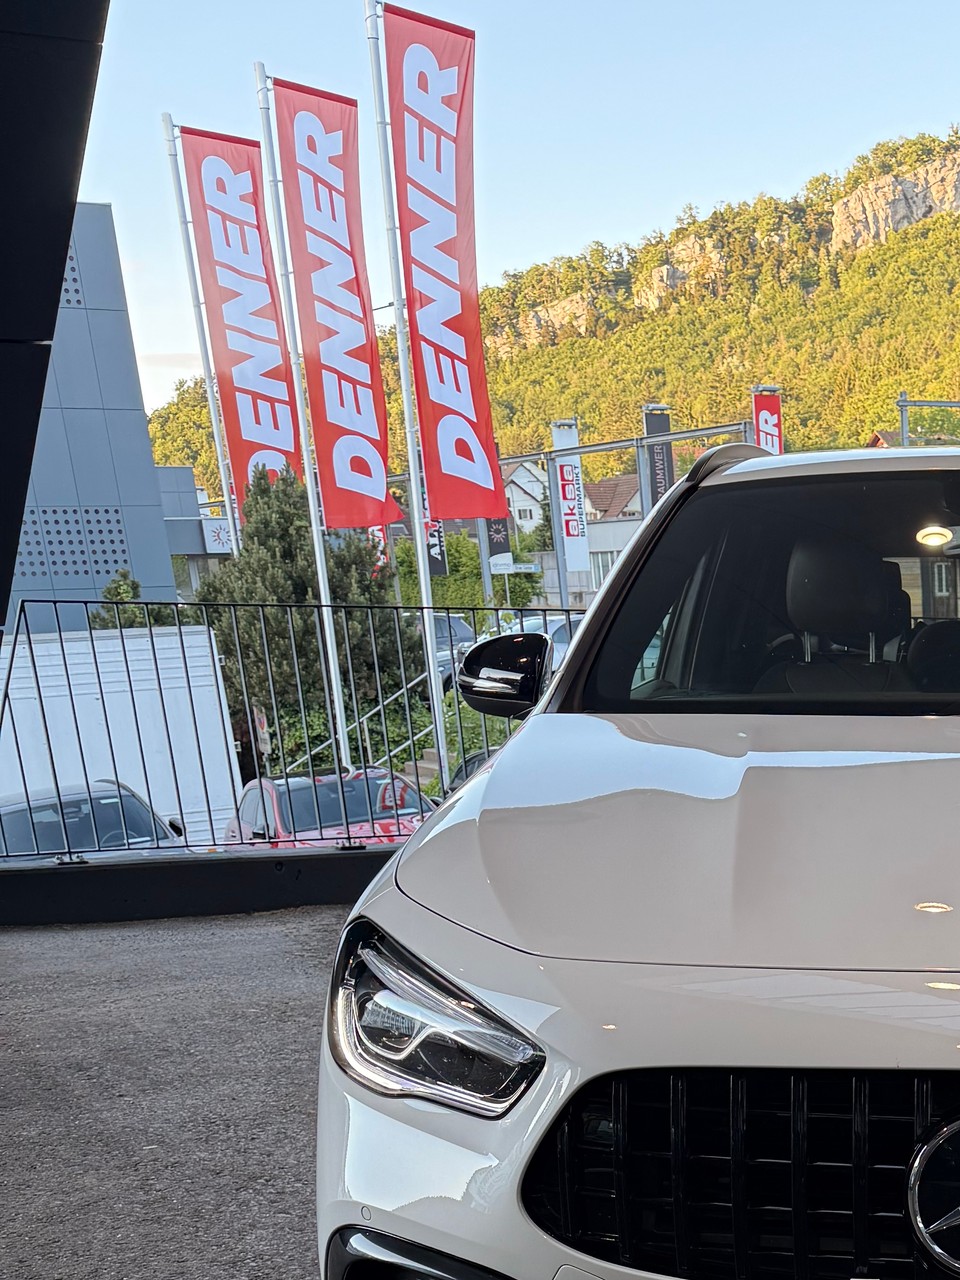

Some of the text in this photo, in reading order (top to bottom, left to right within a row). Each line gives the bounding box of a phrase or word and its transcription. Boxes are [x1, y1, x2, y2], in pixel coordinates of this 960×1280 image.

[293, 110, 387, 502] DENNER
[403, 42, 495, 491] DENNER
[559, 464, 580, 537] aksa
[574, 464, 586, 537] SUPERMARKT
